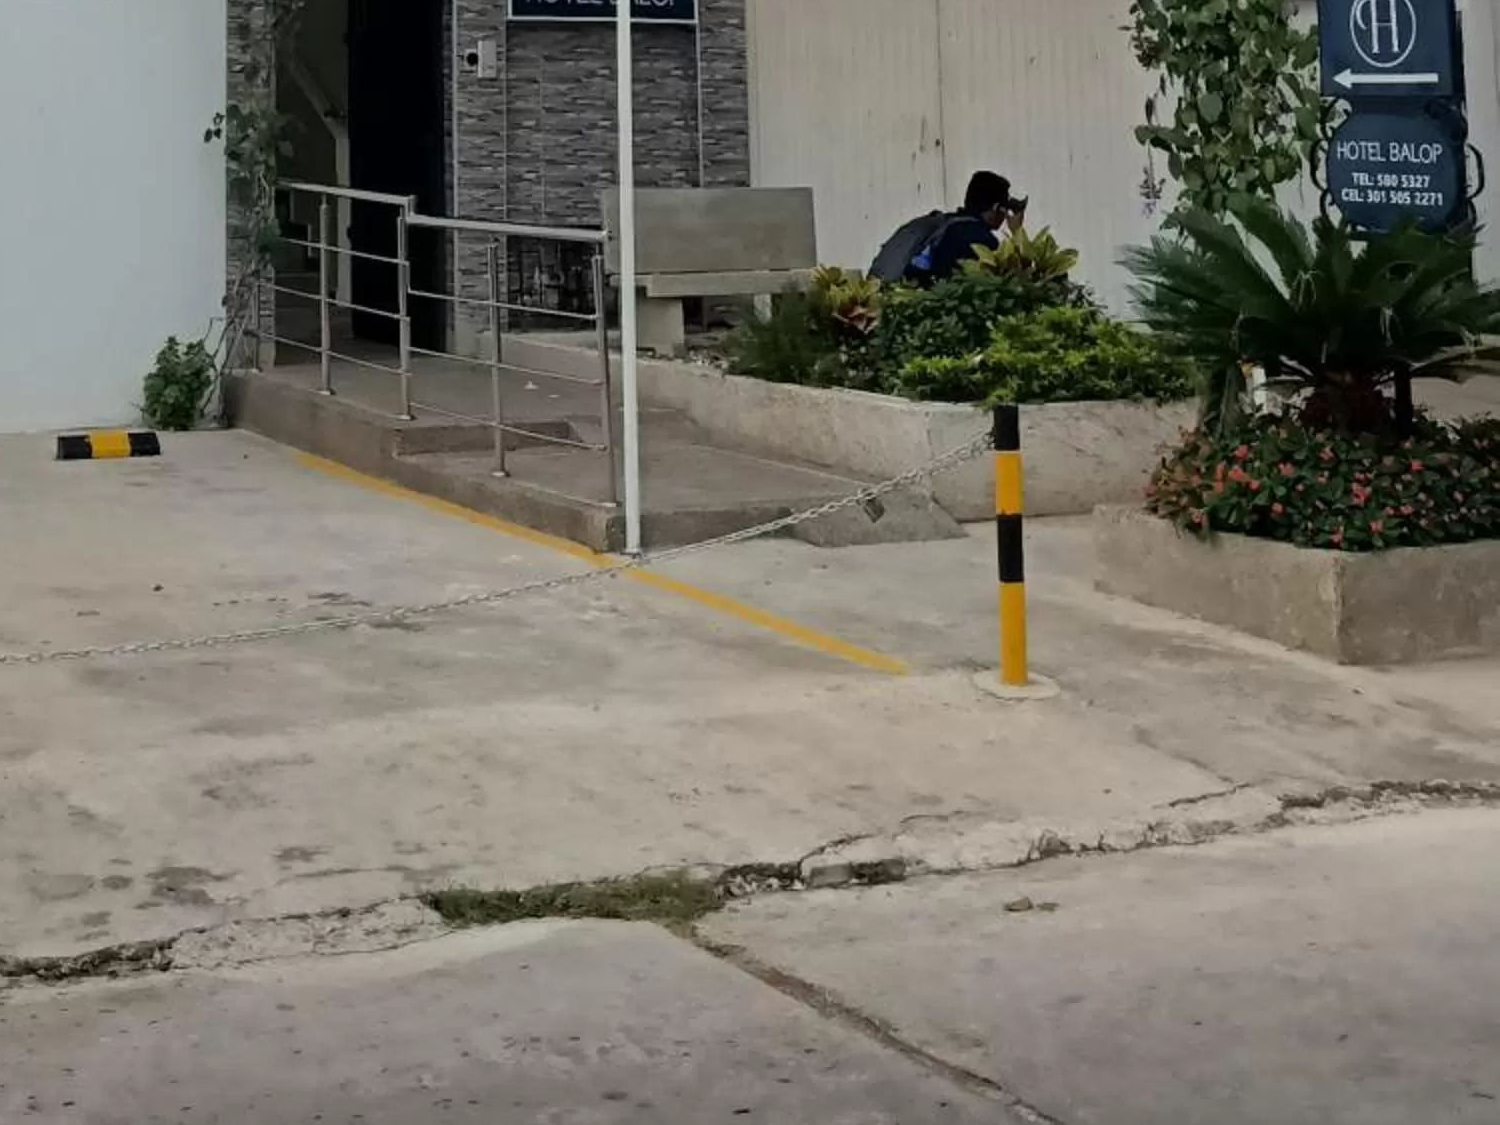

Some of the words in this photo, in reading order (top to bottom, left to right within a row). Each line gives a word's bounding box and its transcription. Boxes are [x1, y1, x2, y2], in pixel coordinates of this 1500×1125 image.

[1337, 140, 1387, 162] HOTEL
[1389, 142, 1443, 164] BALOP
[1352, 172, 1375, 186] TEL:
[1401, 174, 1431, 188] 5327
[1341, 188, 1365, 202] CEL:
[1366, 189, 1387, 203] 301
[1389, 190, 1411, 204] 505
[1414, 191, 1443, 206] 2271
